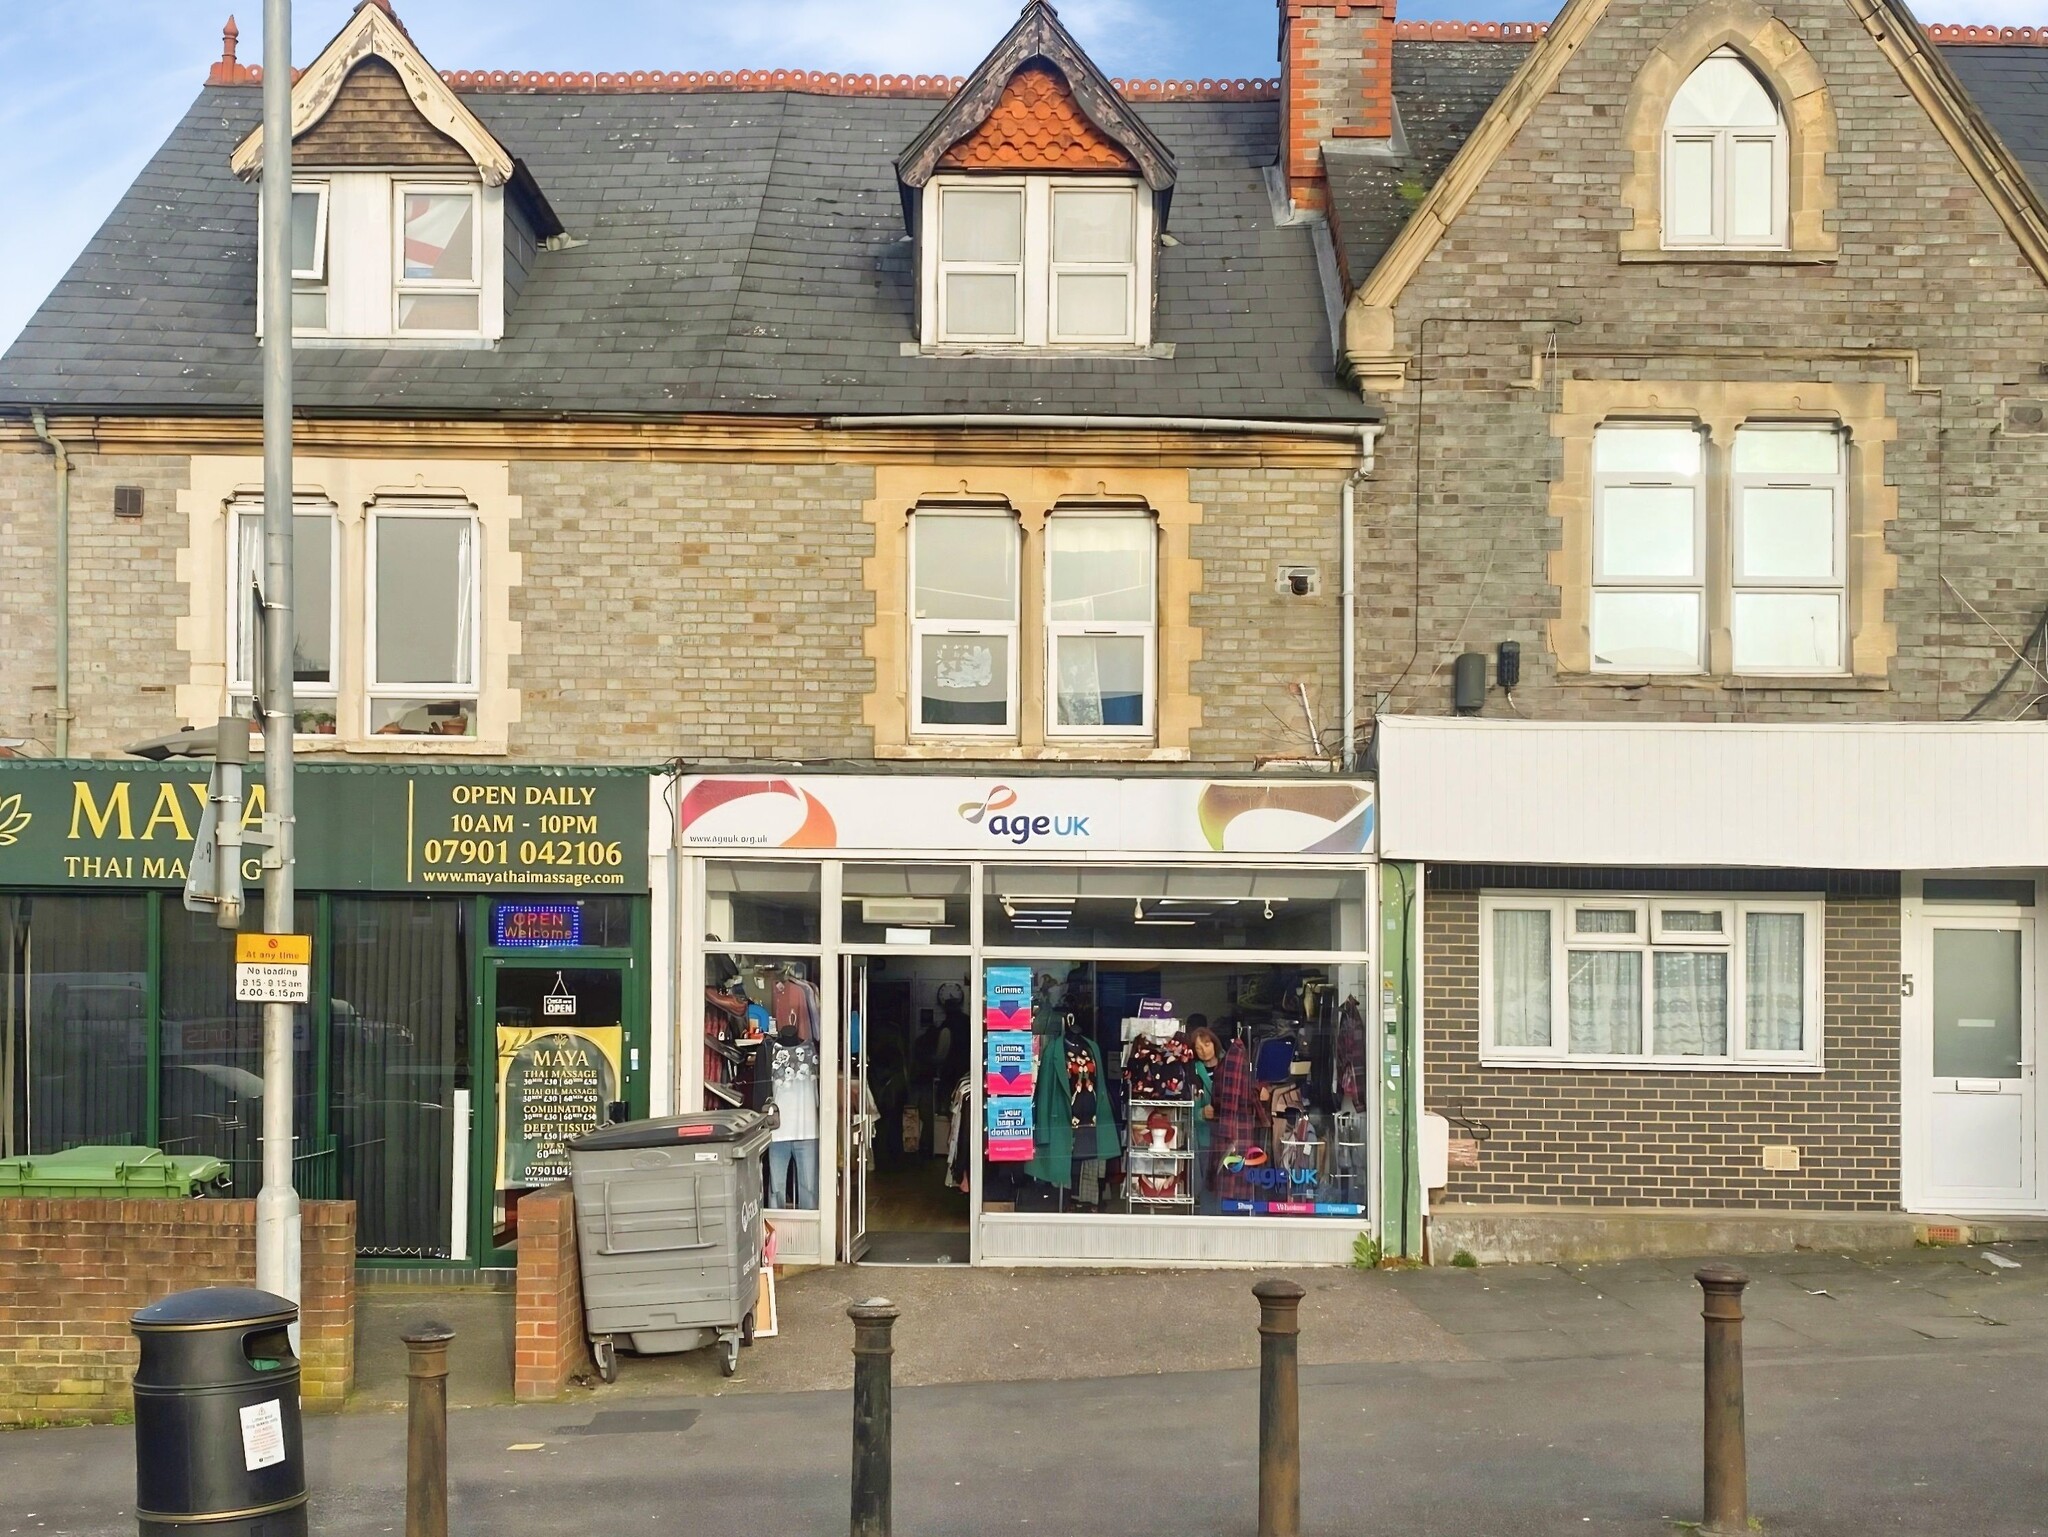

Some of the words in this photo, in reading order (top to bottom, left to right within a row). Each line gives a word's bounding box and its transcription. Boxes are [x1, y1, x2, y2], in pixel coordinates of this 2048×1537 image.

[452, 785, 516, 804] OPEN
[525, 786, 597, 806] DAILY
[450, 814, 514, 833] 10AM
[538, 815, 598, 834] 10PM
[689, 834, 768, 844] www.ageuk.org.uk
[424, 839, 508, 864] 07901
[520, 840, 622, 866] 042106
[64, 856, 133, 879] THAI
[423, 870, 624, 886] www.mayathaimassage.com
[513, 912, 563, 926] OPEN
[504, 926, 573, 939] Welcome
[259, 952, 276, 960] any
[247, 967, 260, 975] No
[263, 967, 298, 977] loading
[1901, 973, 1914, 998] 5
[547, 1004, 572, 1013] OPEN
[533, 1050, 589, 1066] MAYA
[523, 1070, 548, 1078] THAI
[551, 1070, 597, 1078] MASSAGE
[523, 1105, 597, 1113] COMBINATION
[524, 1123, 554, 1132] DEEP
